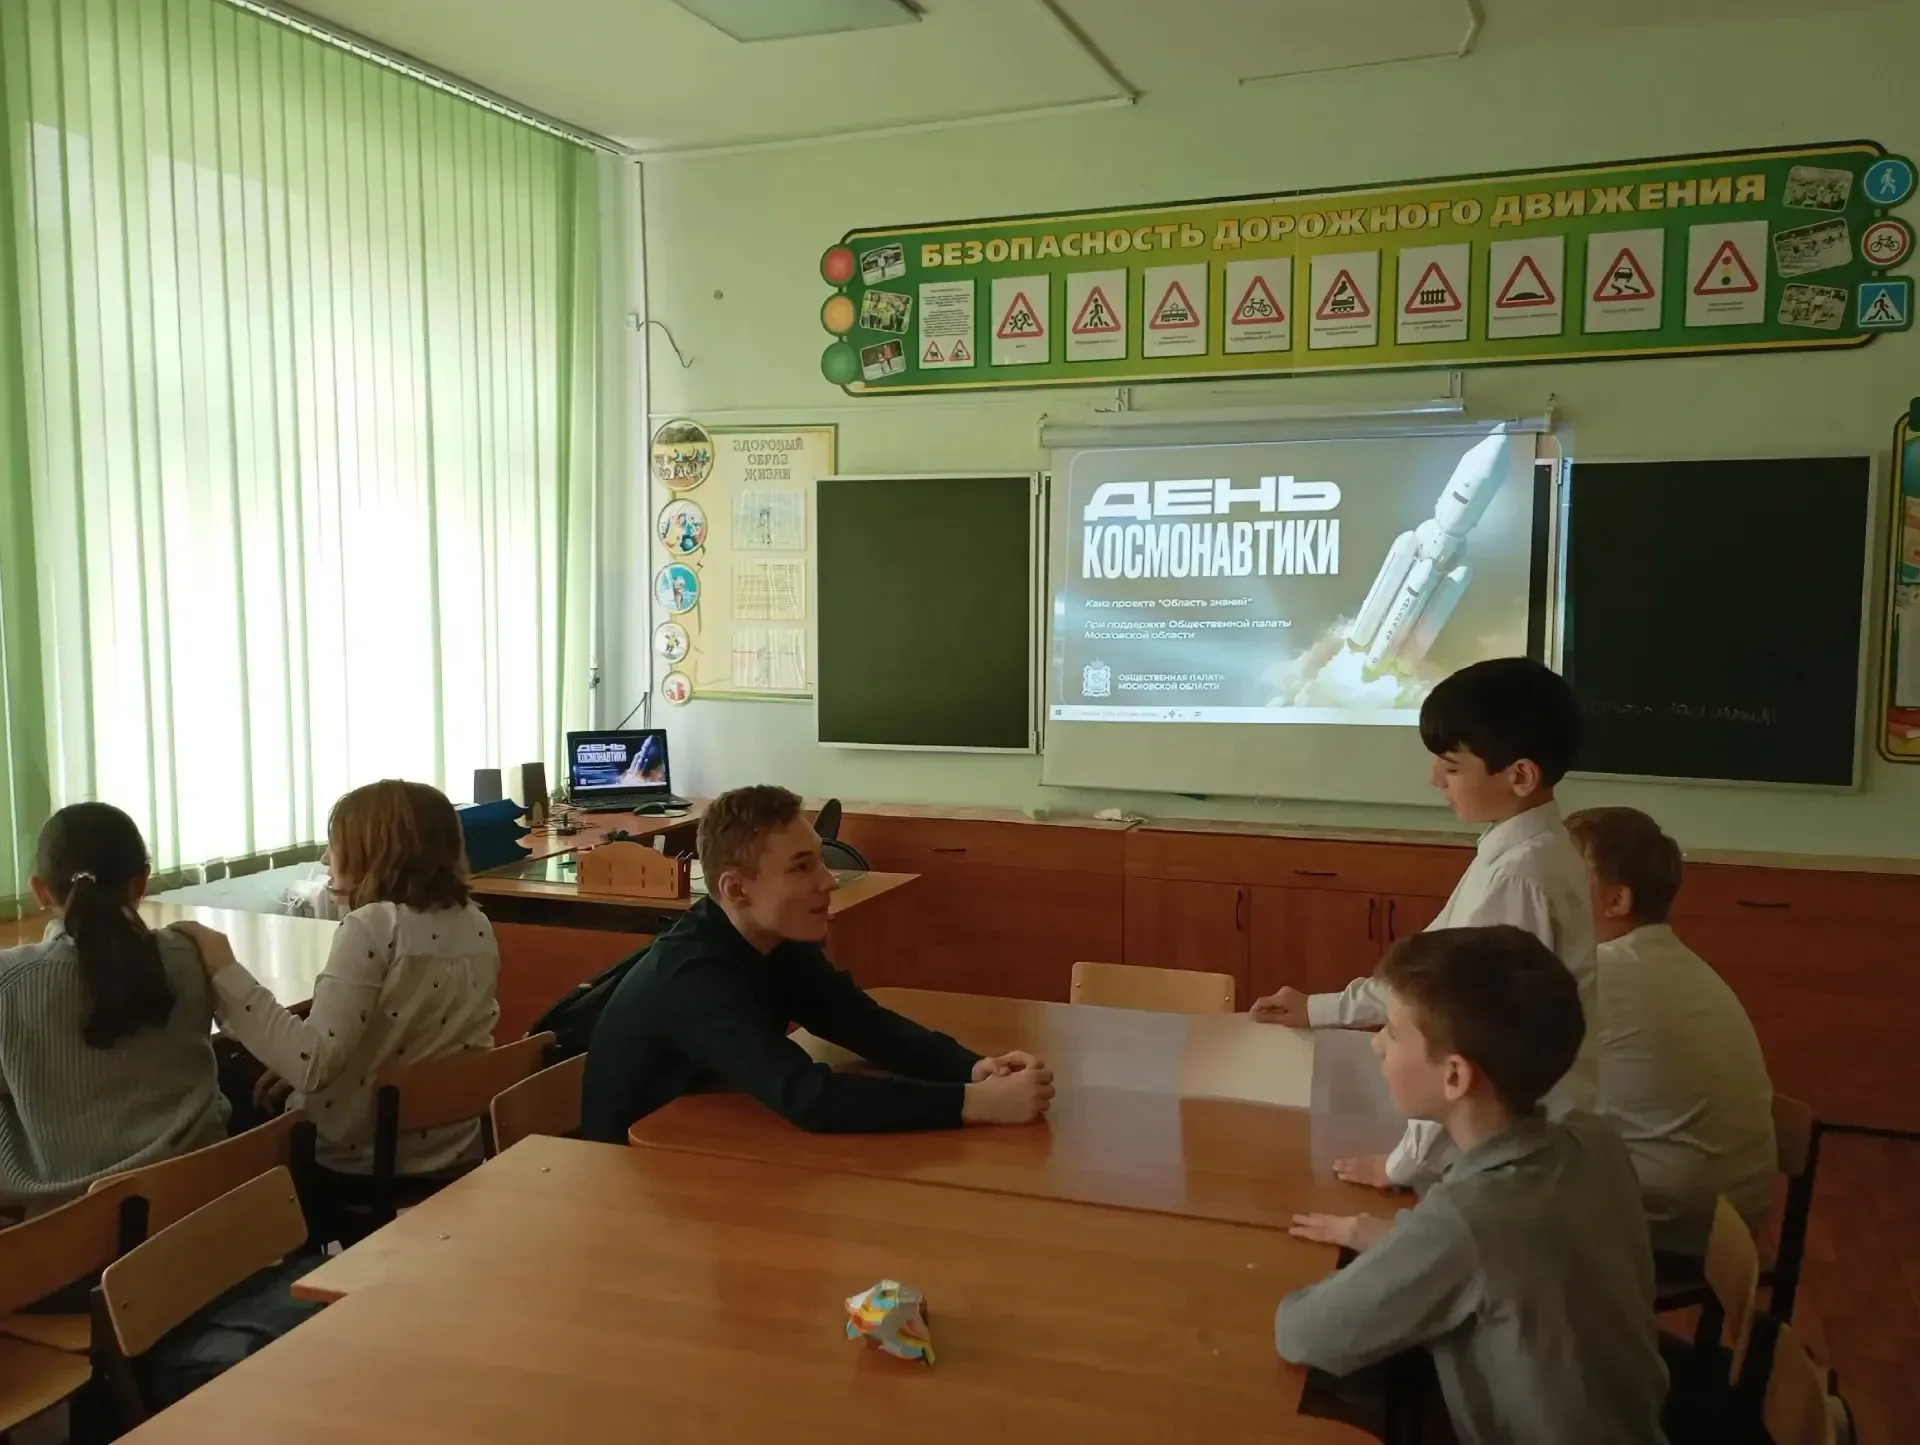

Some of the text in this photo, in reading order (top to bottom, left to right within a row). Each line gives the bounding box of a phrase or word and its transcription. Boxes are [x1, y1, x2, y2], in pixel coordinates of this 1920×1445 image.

[921, 173, 1767, 269] БЕЗОПАСНОСТЬ ДОРОЖНОГО ДВИЖЕНИЯ
[732, 436, 804, 453] ЗДОРОВЫЙ
[747, 453, 789, 466] ОБРАЗ
[743, 468, 791, 481] ЖИЗНИ
[1083, 475, 1342, 521] ДЕНЬ
[1082, 518, 1341, 580] КОСМОНАВТИКИ
[1111, 600, 1156, 609] проекта
[1084, 618, 1292, 630] При поддержке Общественной палаты
[1084, 630, 1196, 639] Московской области
[1118, 673, 1225, 682] ОБЩЕСТВЕННАЯ ПАЛАТА
[1118, 682, 1220, 691] МОСКОВСКОЙ ОБЛАСТИ
[577, 743, 626, 752] ДЕНЬ
